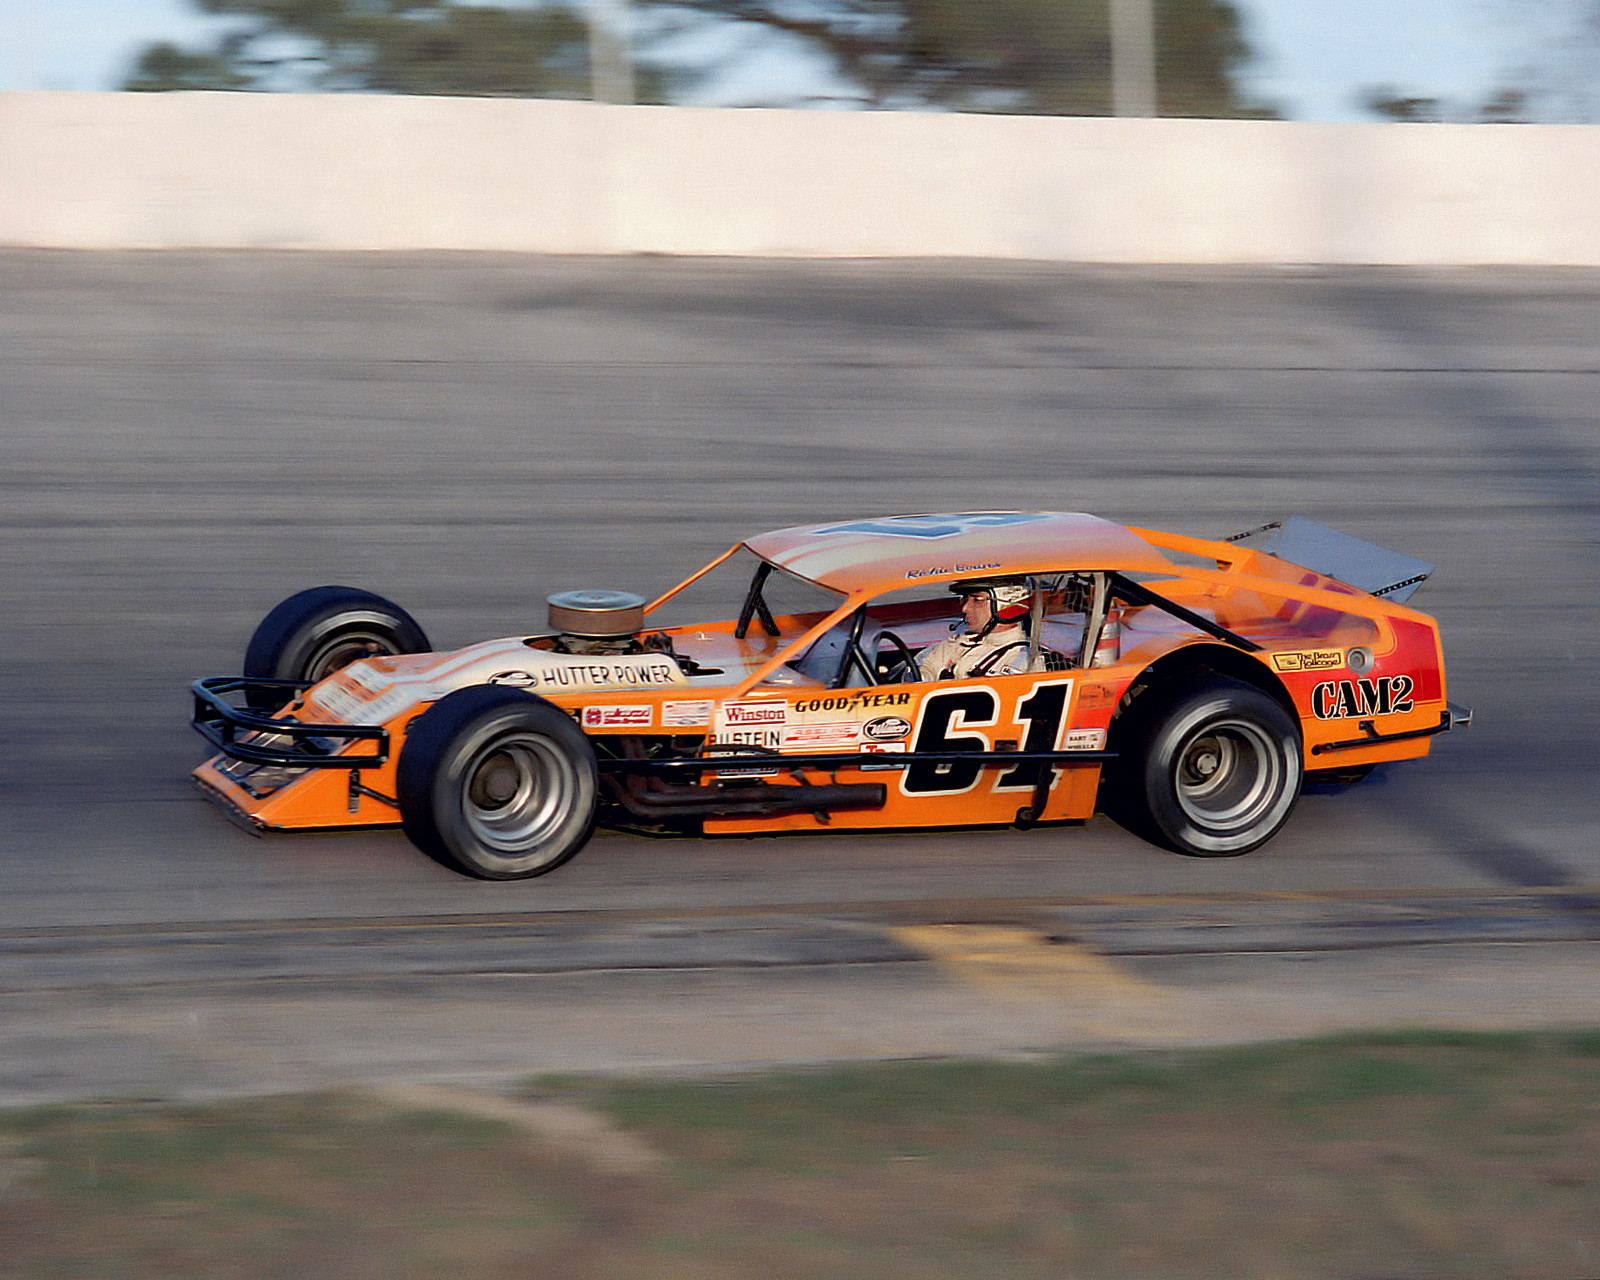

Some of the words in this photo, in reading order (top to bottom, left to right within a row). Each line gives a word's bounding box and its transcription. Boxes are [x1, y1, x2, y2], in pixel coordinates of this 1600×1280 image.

[542, 665, 610, 686] HUTTER
[613, 664, 675, 684] POWER
[1312, 675, 1414, 720] CAM2
[726, 707, 786, 722] Winston
[899, 679, 1074, 797] 61
